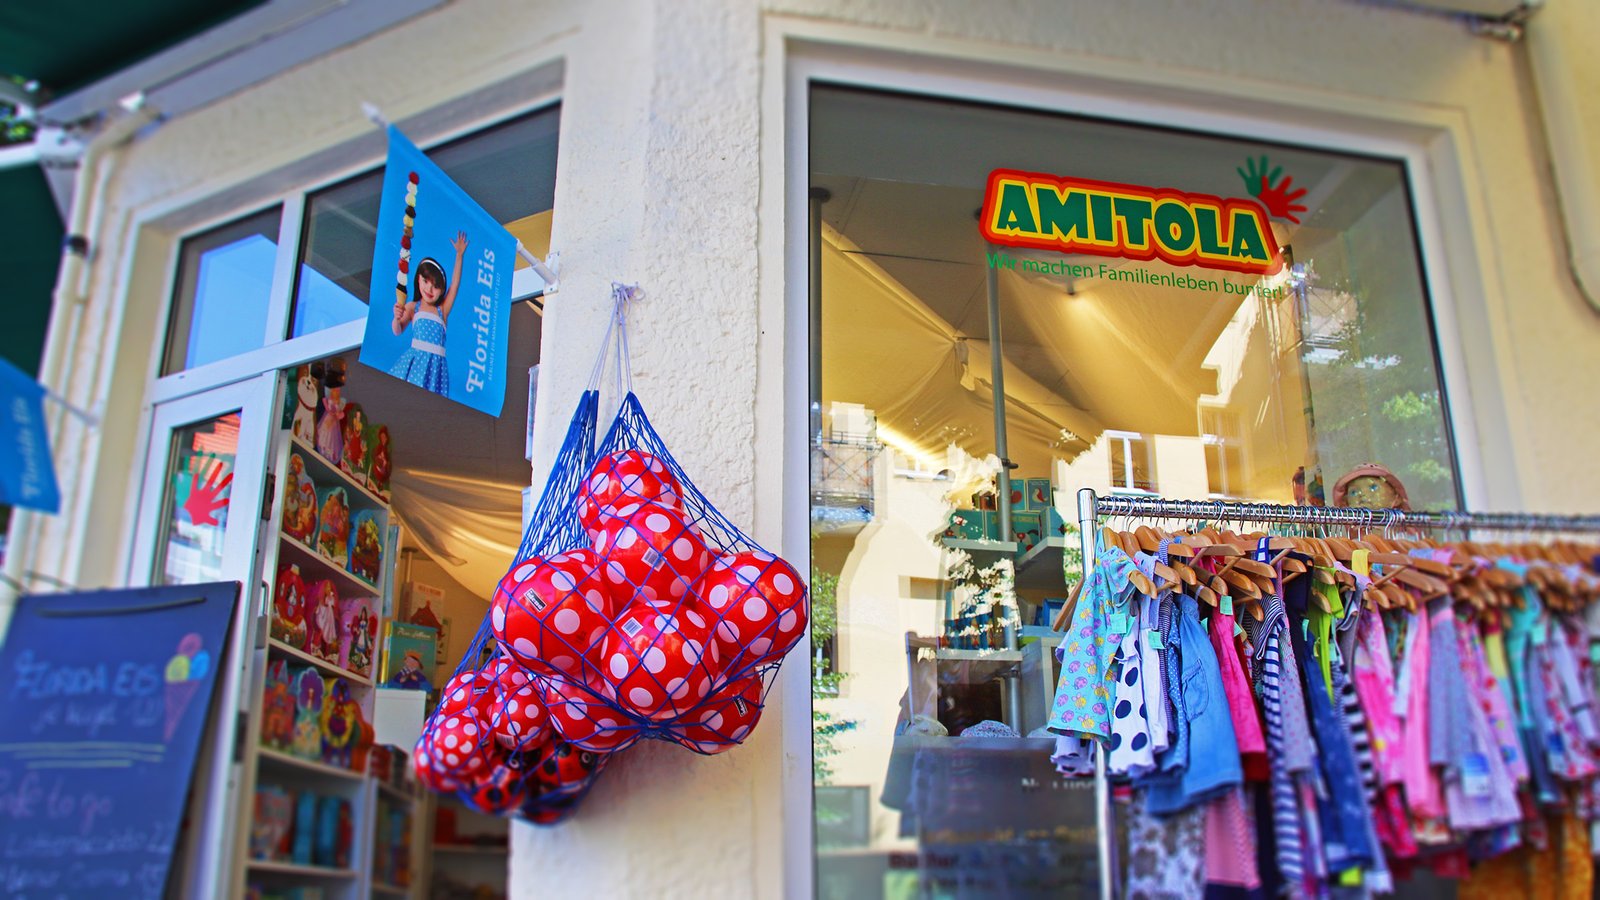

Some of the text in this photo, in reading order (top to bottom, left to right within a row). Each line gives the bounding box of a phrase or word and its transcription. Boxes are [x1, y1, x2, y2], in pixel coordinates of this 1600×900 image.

[993, 180, 1271, 264] AMITOLA
[986, 252, 1284, 300] Wir machen Familienleben bunter!
[465, 248, 496, 393] Florida Eis
